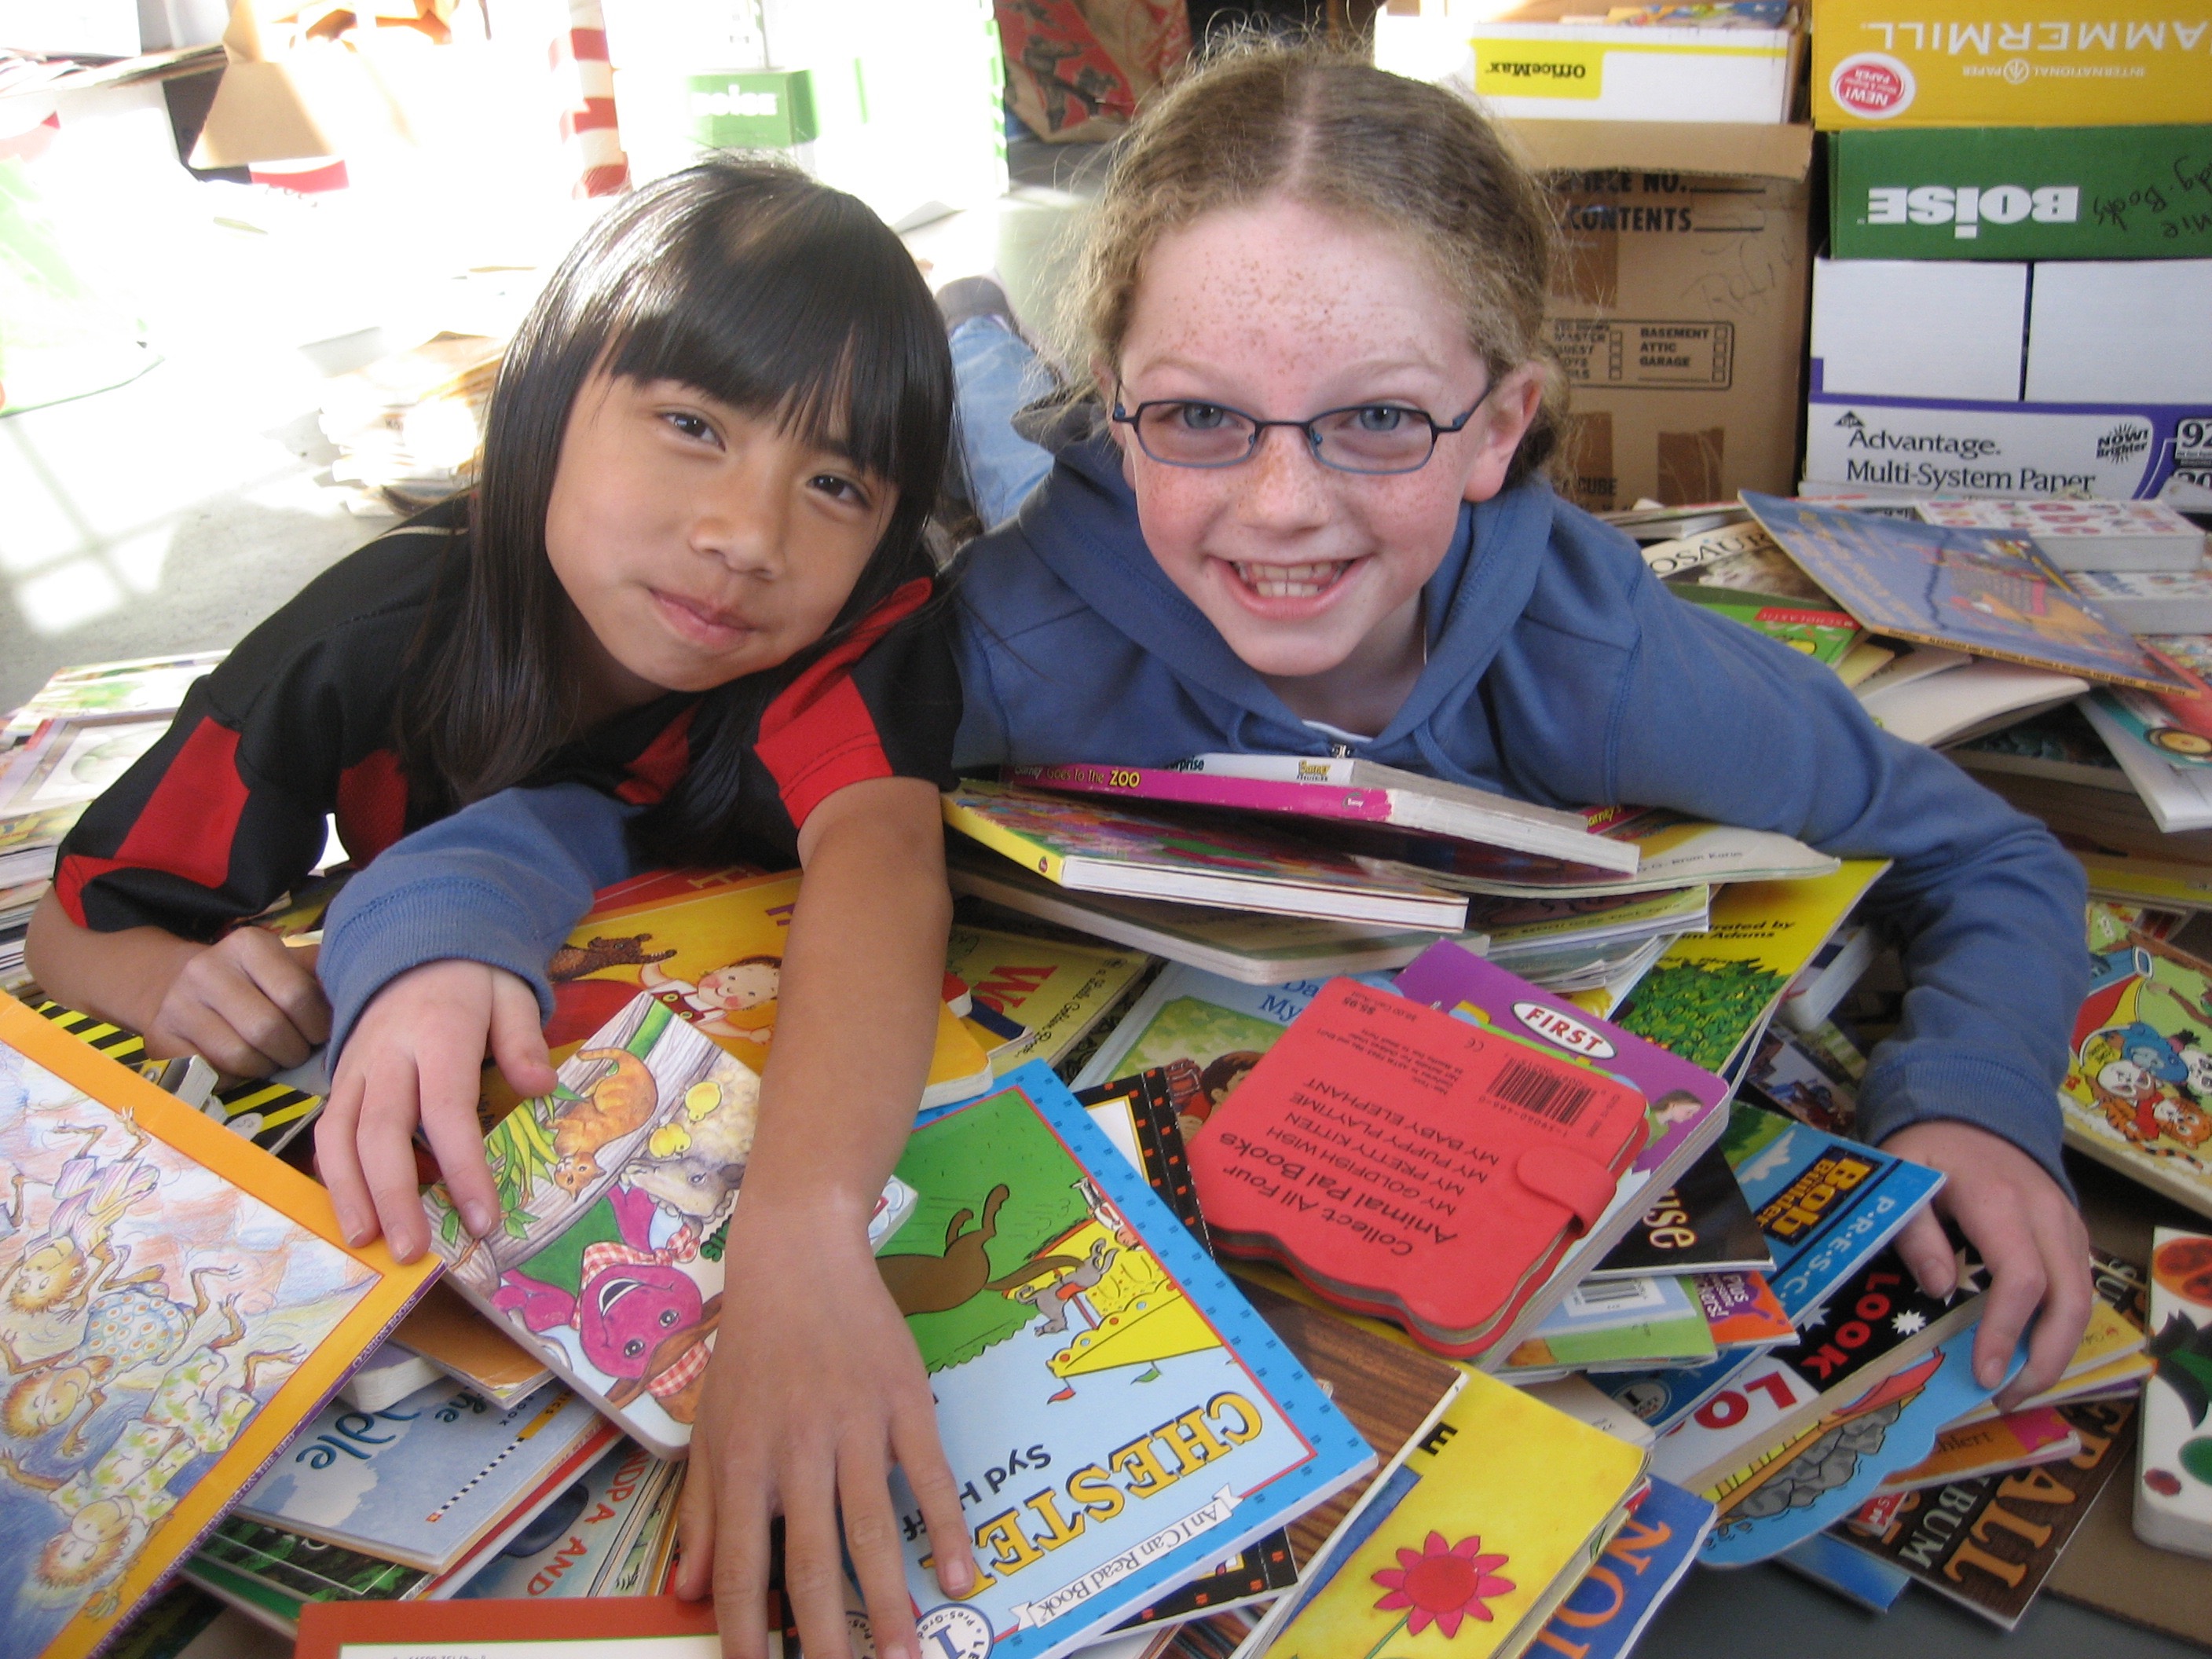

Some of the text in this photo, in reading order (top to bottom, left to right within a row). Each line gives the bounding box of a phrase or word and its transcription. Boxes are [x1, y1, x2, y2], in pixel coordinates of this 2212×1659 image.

[1490, 62, 1586, 79] OfficeMax
[1845, 89, 1890, 106] NEW!
[1639, 356, 1690, 368] GARAGE
[1640, 327, 1708, 339] BASEMENT
[1640, 342, 1676, 353] ATTIC
[1847, 460, 2096, 494] Multi-System Paper
[1109, 770, 1141, 789] ZOO
[1523, 1006, 1605, 1053] FIRST
[1284, 1111, 1466, 1198] MY PRETTY KITTEN
[1290, 1090, 1489, 1185] MY PUPPY PLAYTIME
[1304, 1075, 1500, 1167] MY BABY ELEPHANT
[1216, 1130, 1458, 1250] Animal Pal Books
[1266, 1125, 1457, 1217] MY GOLDFISH WISH
[1772, 1158, 1873, 1236] Bob
[1221, 1162, 1415, 1260] Collect All Four
[350, 1295, 419, 1369] CLARION BOOKS
[1800, 1272, 1902, 1380] LOOK
[1666, 1370, 1797, 1437] LO
[983, 1444, 1051, 1495] Syd
[152, 1538, 200, 1590] MONKEYS
[200, 1490, 244, 1537] JUMPING
[241, 1474, 258, 1492] ON
[255, 1452, 277, 1476] THE
[274, 1431, 297, 1455] BED
[526, 1536, 589, 1595] AND
[1038, 1503, 1218, 1618] An I Can Read Book
